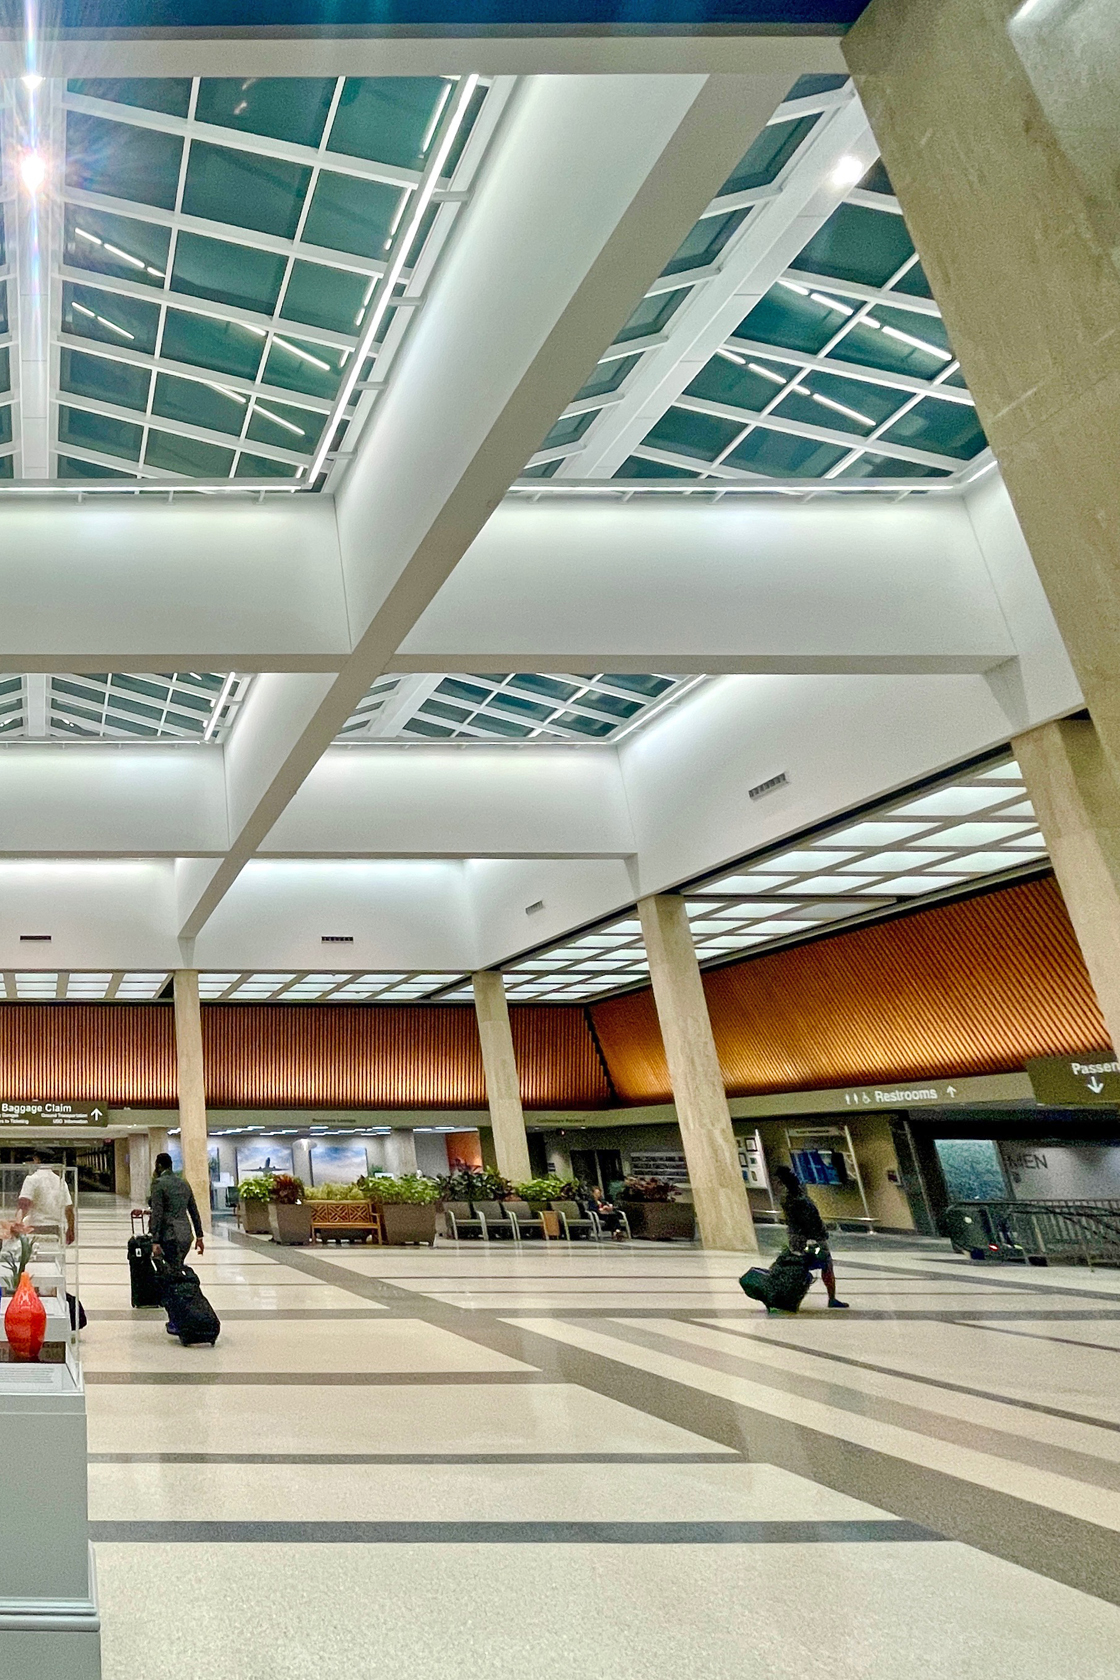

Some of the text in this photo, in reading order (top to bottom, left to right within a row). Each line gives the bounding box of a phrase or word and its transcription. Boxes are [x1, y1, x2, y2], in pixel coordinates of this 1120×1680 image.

[875, 1089, 938, 1103] Restrooms
[1, 1103, 72, 1114] Baggage Claim
